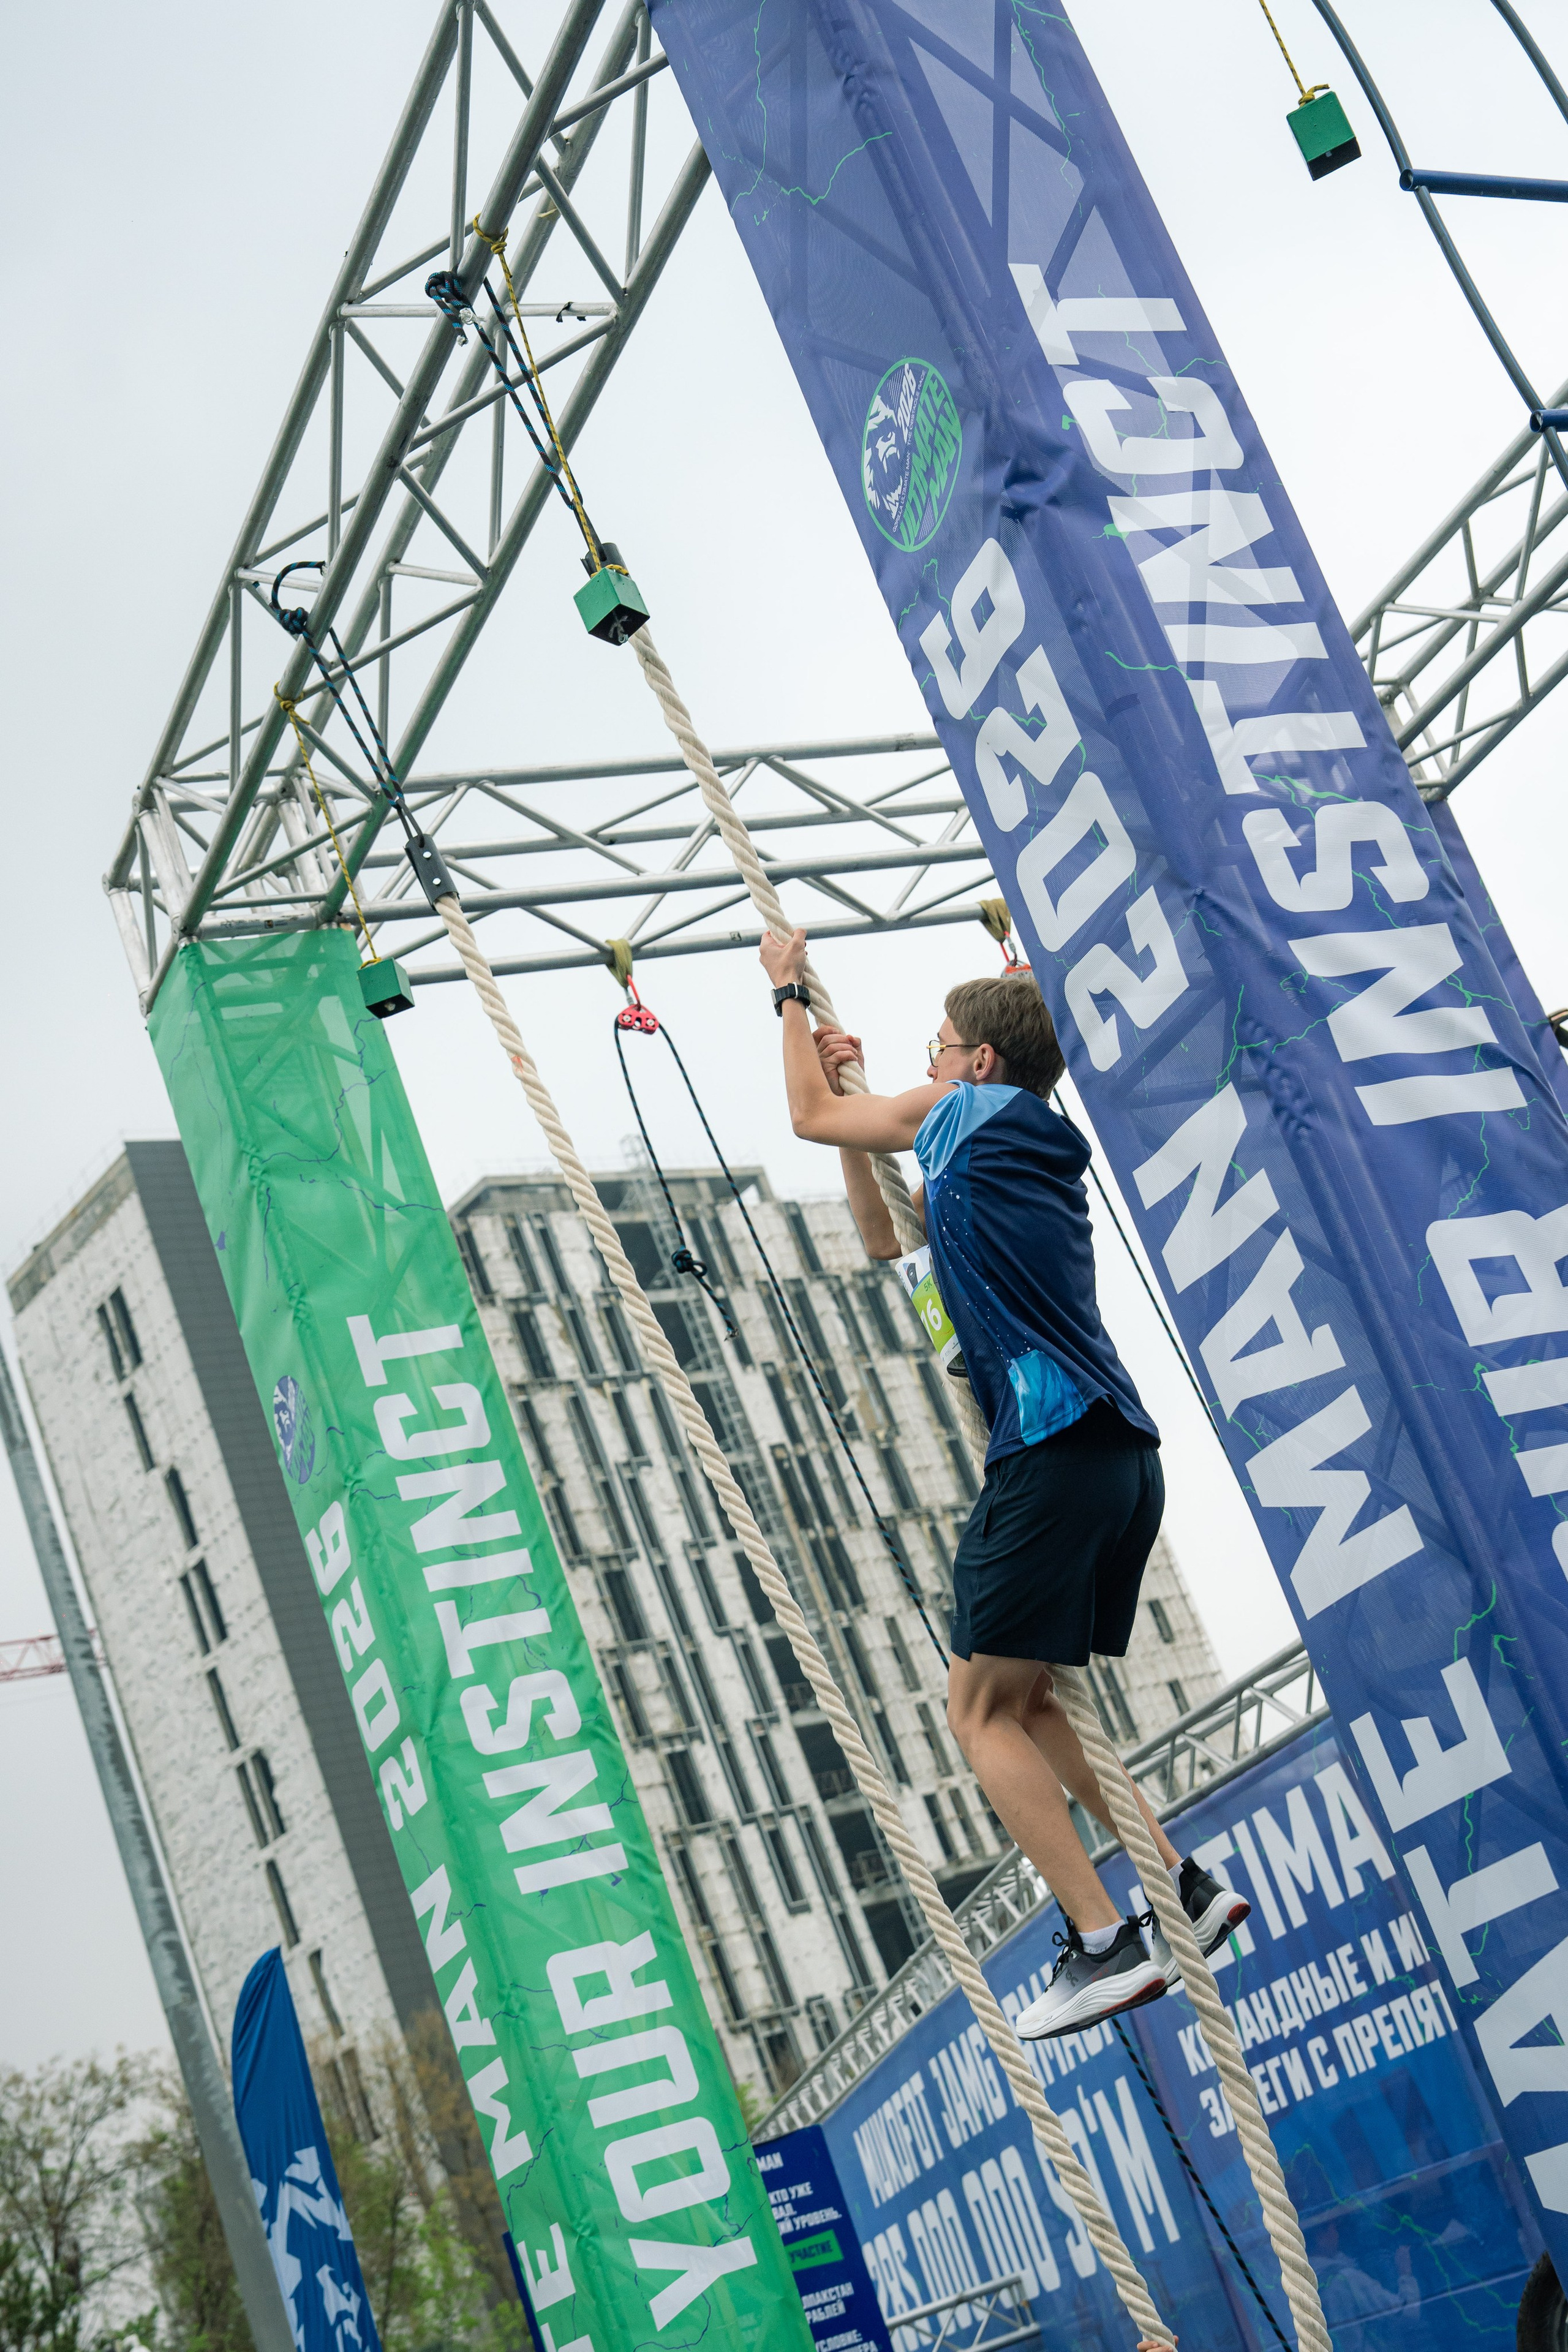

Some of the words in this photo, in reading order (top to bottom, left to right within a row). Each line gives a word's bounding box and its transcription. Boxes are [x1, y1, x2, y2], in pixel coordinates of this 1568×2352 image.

[897, 363, 916, 443] 2026
[910, 391, 919, 430] OBSTACLE
[918, 370, 926, 390] RACE
[892, 505, 903, 532] GORILLA
[1008, 263, 1528, 1126] INSTINCT
[919, 537, 1189, 1072] 2026
[923, 1280, 933, 1292] 5K
[1133, 1082, 1424, 1620] MAN
[305, 1501, 428, 1831] 2026
[346, 1314, 629, 1895] INSTINCT
[410, 1864, 533, 2180] MAN
[1177, 1942, 1366, 2076] КАНДНЫЕ
[1360, 1928, 1396, 1986] И
[1199, 2046, 1314, 2138] ЗЕГИ
[1306, 2035, 1339, 2089] С
[546, 1929, 758, 2332] YOUR
[788, 2182, 813, 2200] УЖЕ
[907, 2187, 987, 2337] 000
[962, 2145, 1061, 2309] 000
